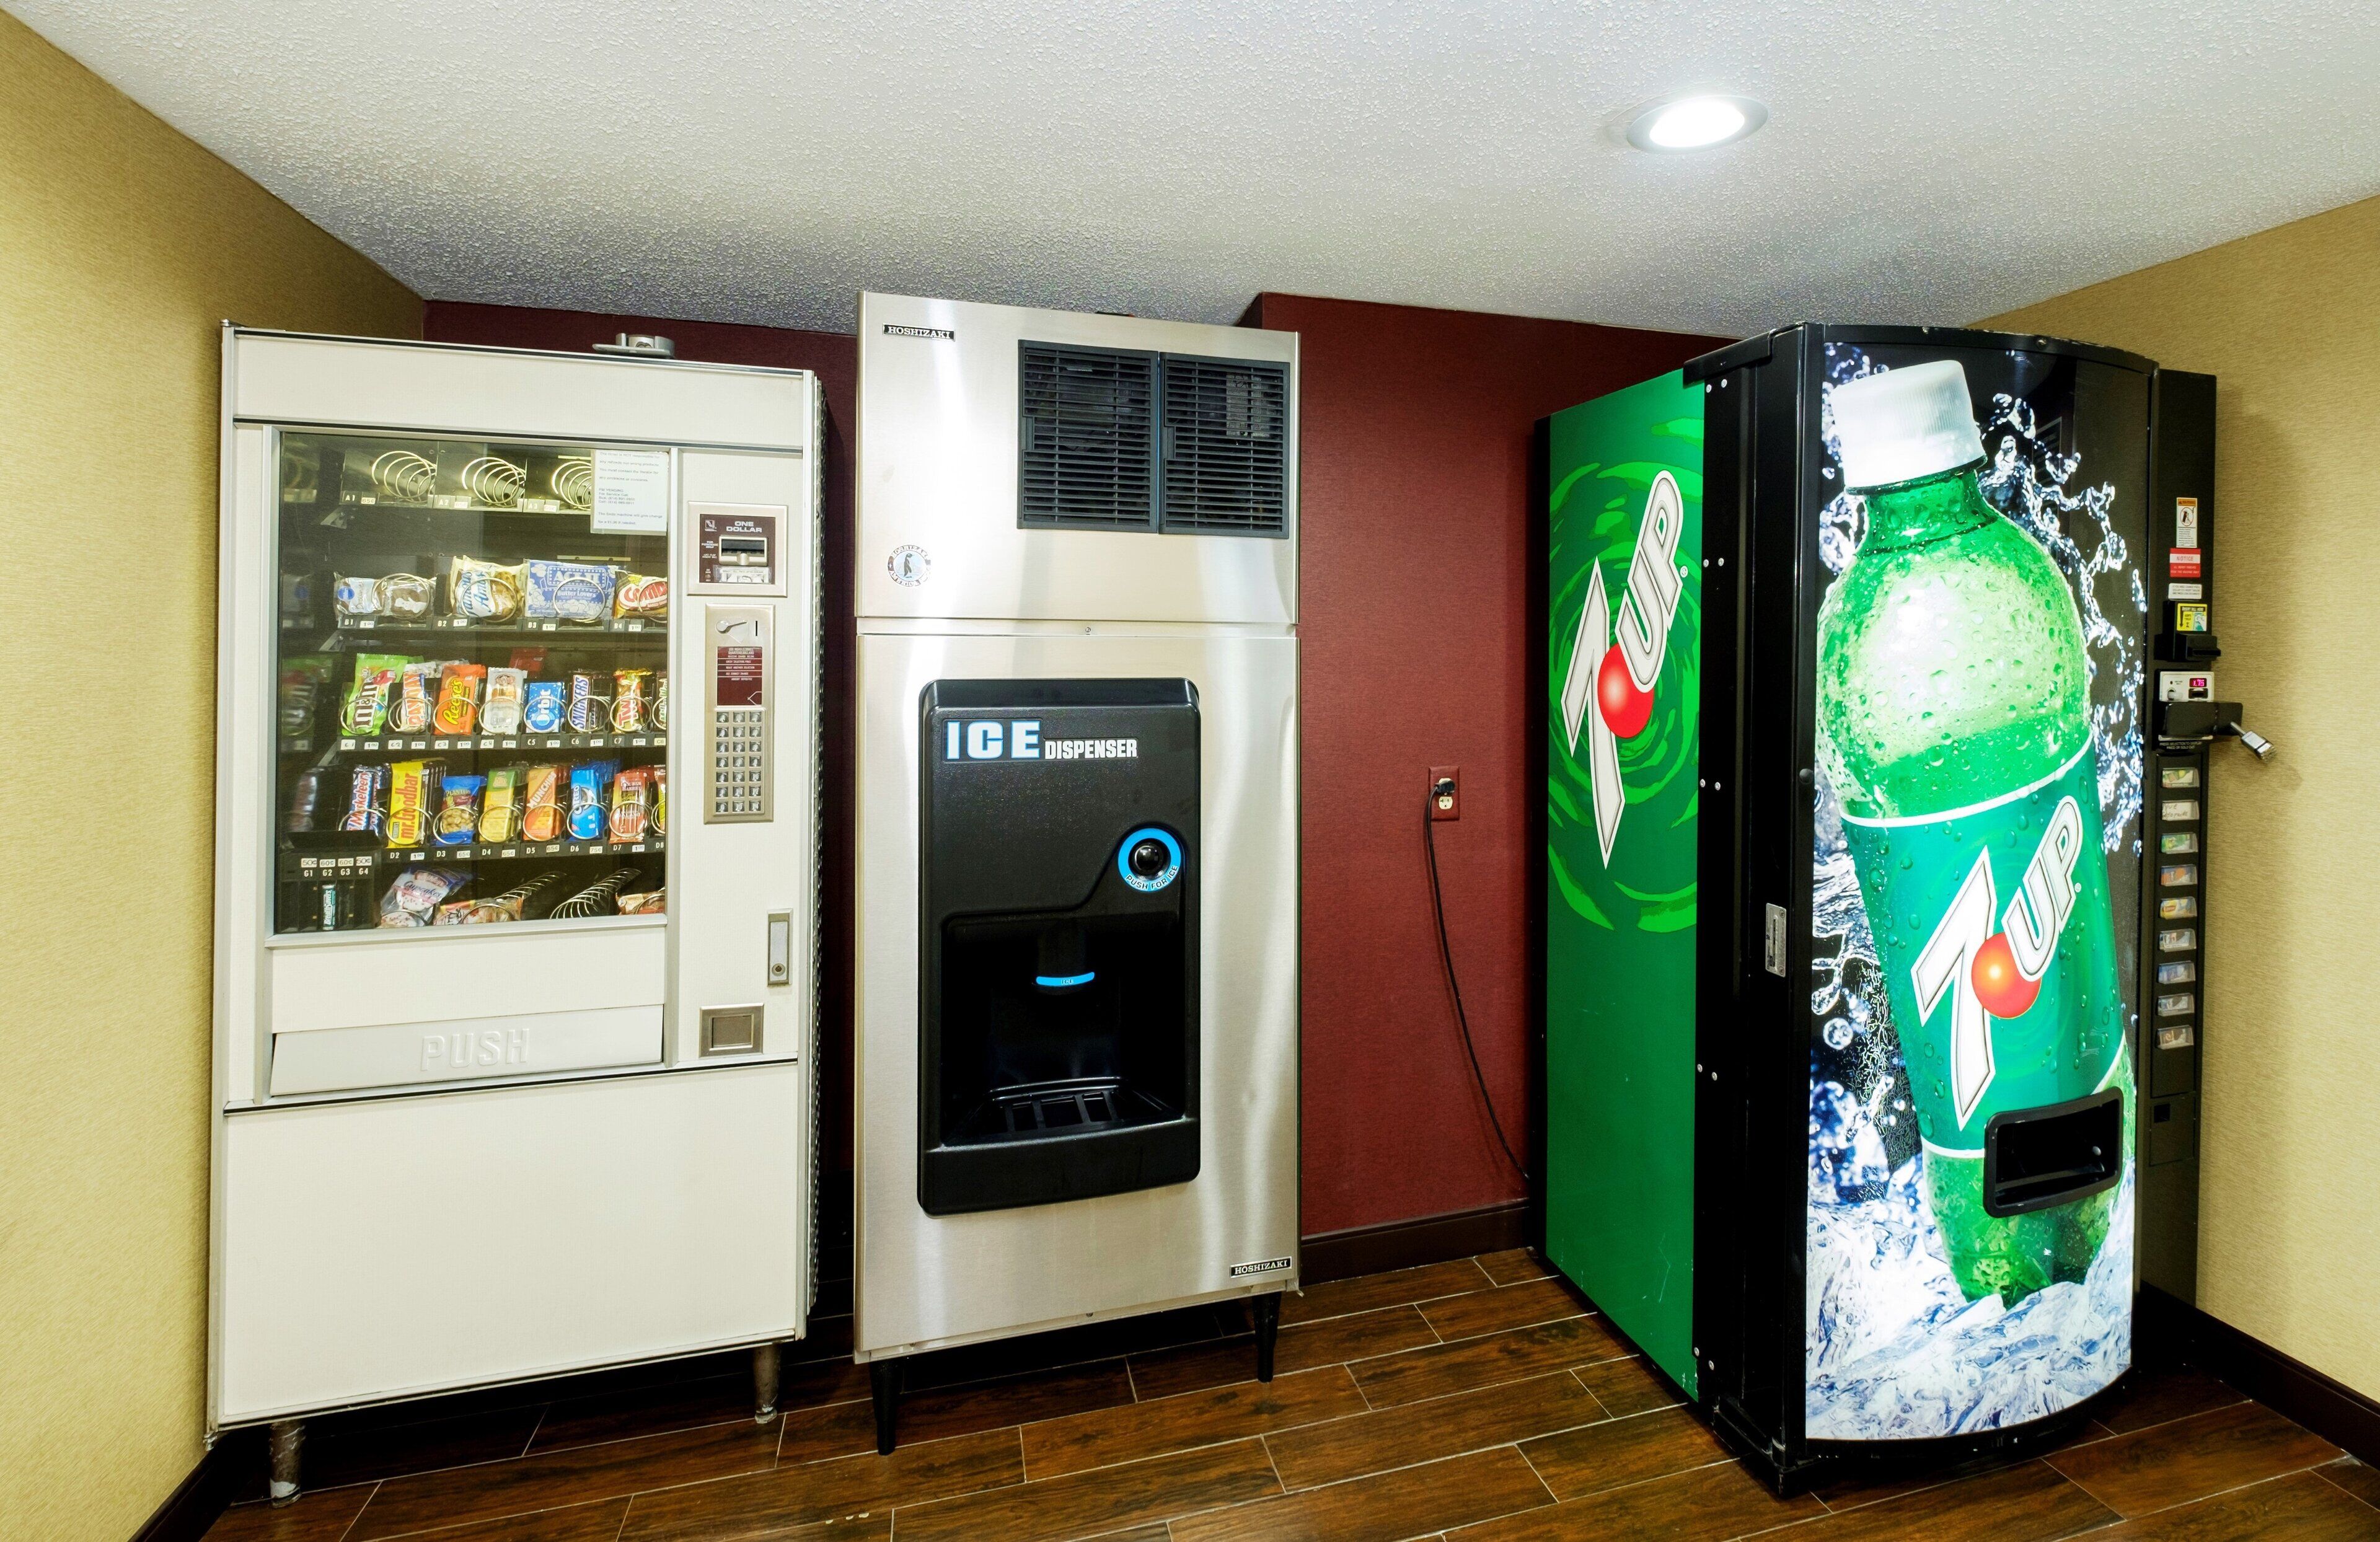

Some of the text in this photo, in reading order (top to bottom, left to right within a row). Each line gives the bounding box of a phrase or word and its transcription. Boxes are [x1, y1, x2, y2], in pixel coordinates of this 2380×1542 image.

[888, 326, 951, 339] HOSHIZAKI
[1561, 470, 1683, 870] 7UP
[403, 672, 426, 727] PAYDAY
[443, 677, 464, 726] Reese's
[571, 676, 590, 730] SNICKERS
[946, 720, 1137, 760] ICE DISPENSER
[572, 784, 583, 815] OREO
[404, 881, 441, 898] Cupcakes
[1126, 865, 1178, 889] PUSH FOR ICE
[1910, 795, 2083, 1132] 7UP
[420, 1028, 530, 1072] PUSH
[1234, 1260, 1288, 1274] HOSHIZAKI
